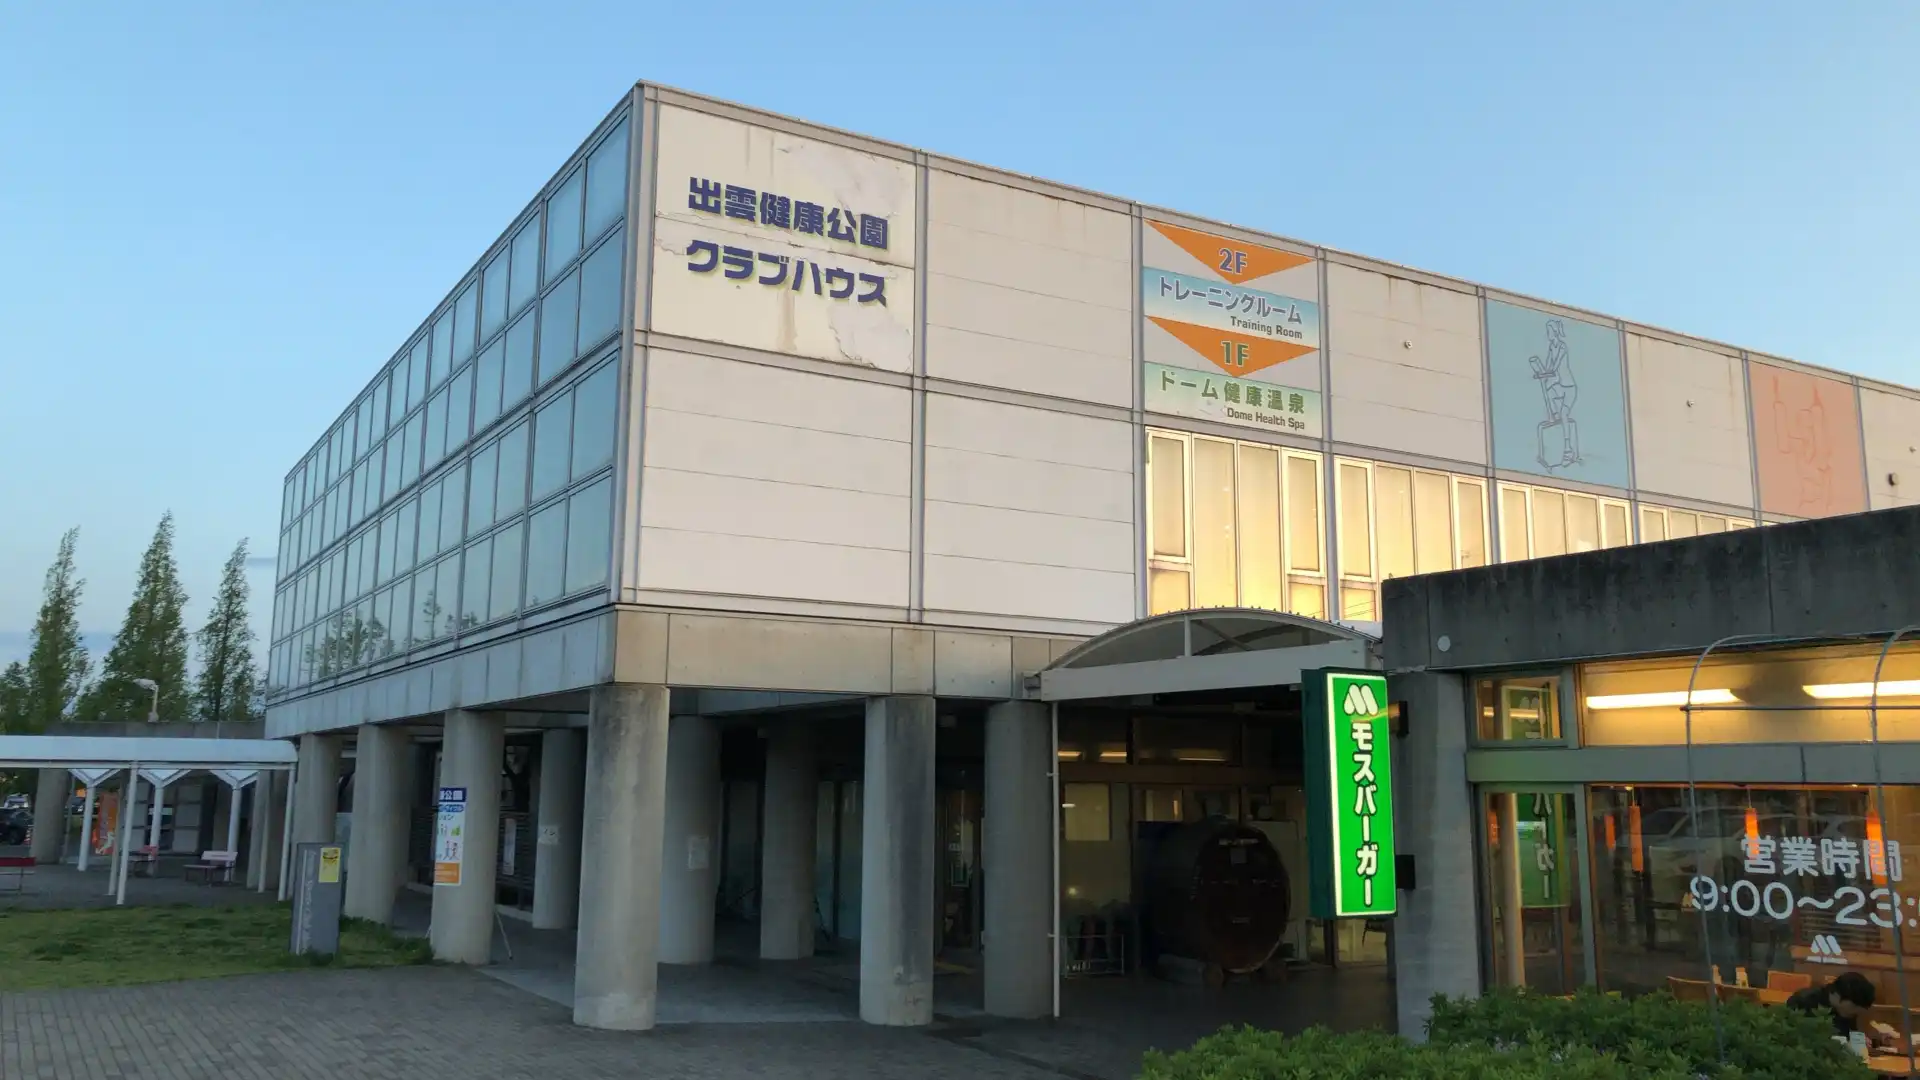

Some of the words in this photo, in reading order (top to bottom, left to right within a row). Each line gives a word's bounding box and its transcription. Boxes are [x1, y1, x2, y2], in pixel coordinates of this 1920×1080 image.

[688, 176, 888, 250] 出雲健康公園
[686, 239, 888, 307] クラブハウス
[1218, 248, 1248, 274] 2F
[1159, 276, 1303, 325] トレーニングルーム
[1230, 315, 1273, 336] Training
[1275, 325, 1303, 340] Room
[1220, 340, 1249, 366] 1F
[1161, 370, 1305, 415] ドーム健康温泉
[1226, 406, 1253, 422] Dome
[1255, 410, 1286, 427] Health
[1288, 416, 1305, 431] Spa
[1351, 721, 1379, 907] モスバーガー
[1740, 834, 1903, 882] 営業時間
